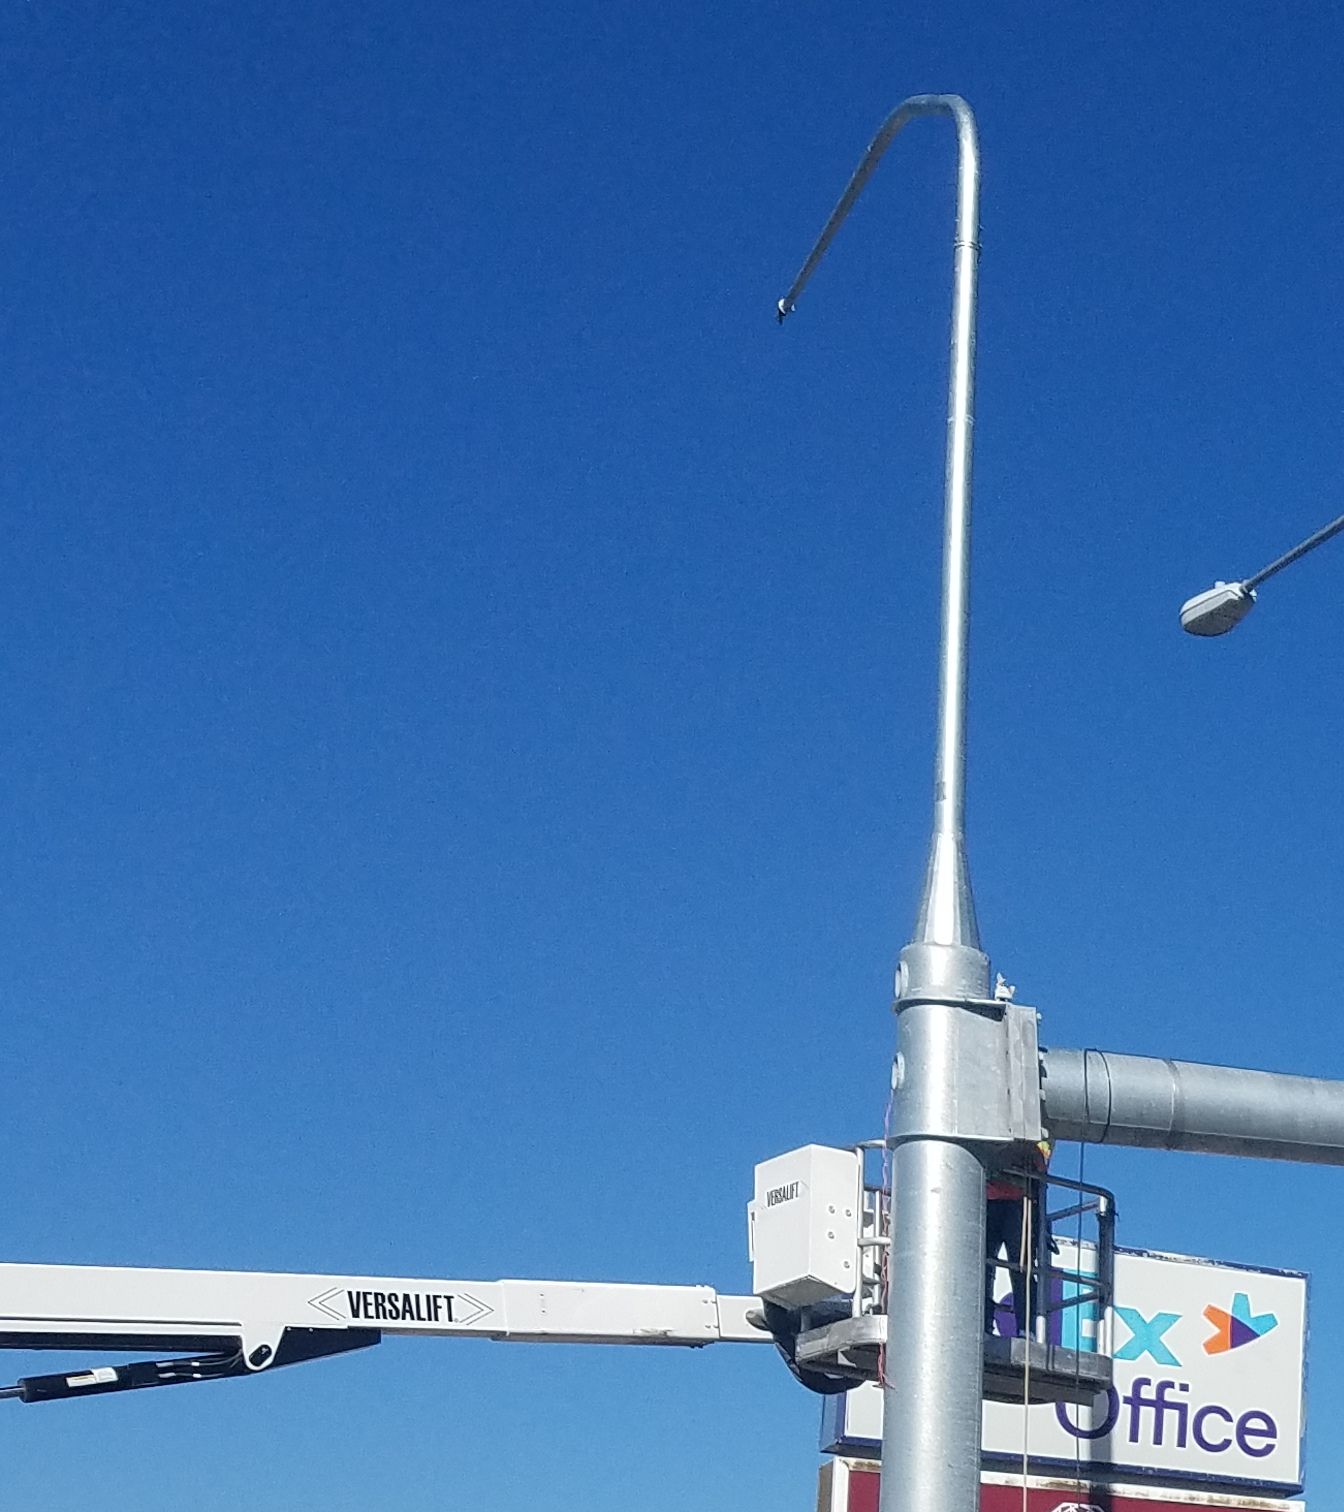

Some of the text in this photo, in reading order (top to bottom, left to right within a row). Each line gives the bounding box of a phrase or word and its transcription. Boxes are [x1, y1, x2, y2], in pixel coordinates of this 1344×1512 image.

[766, 1181, 799, 1207] VERSALIFT
[347, 1291, 455, 1322] VERSALIFT
[1055, 1377, 1278, 1458] Office
